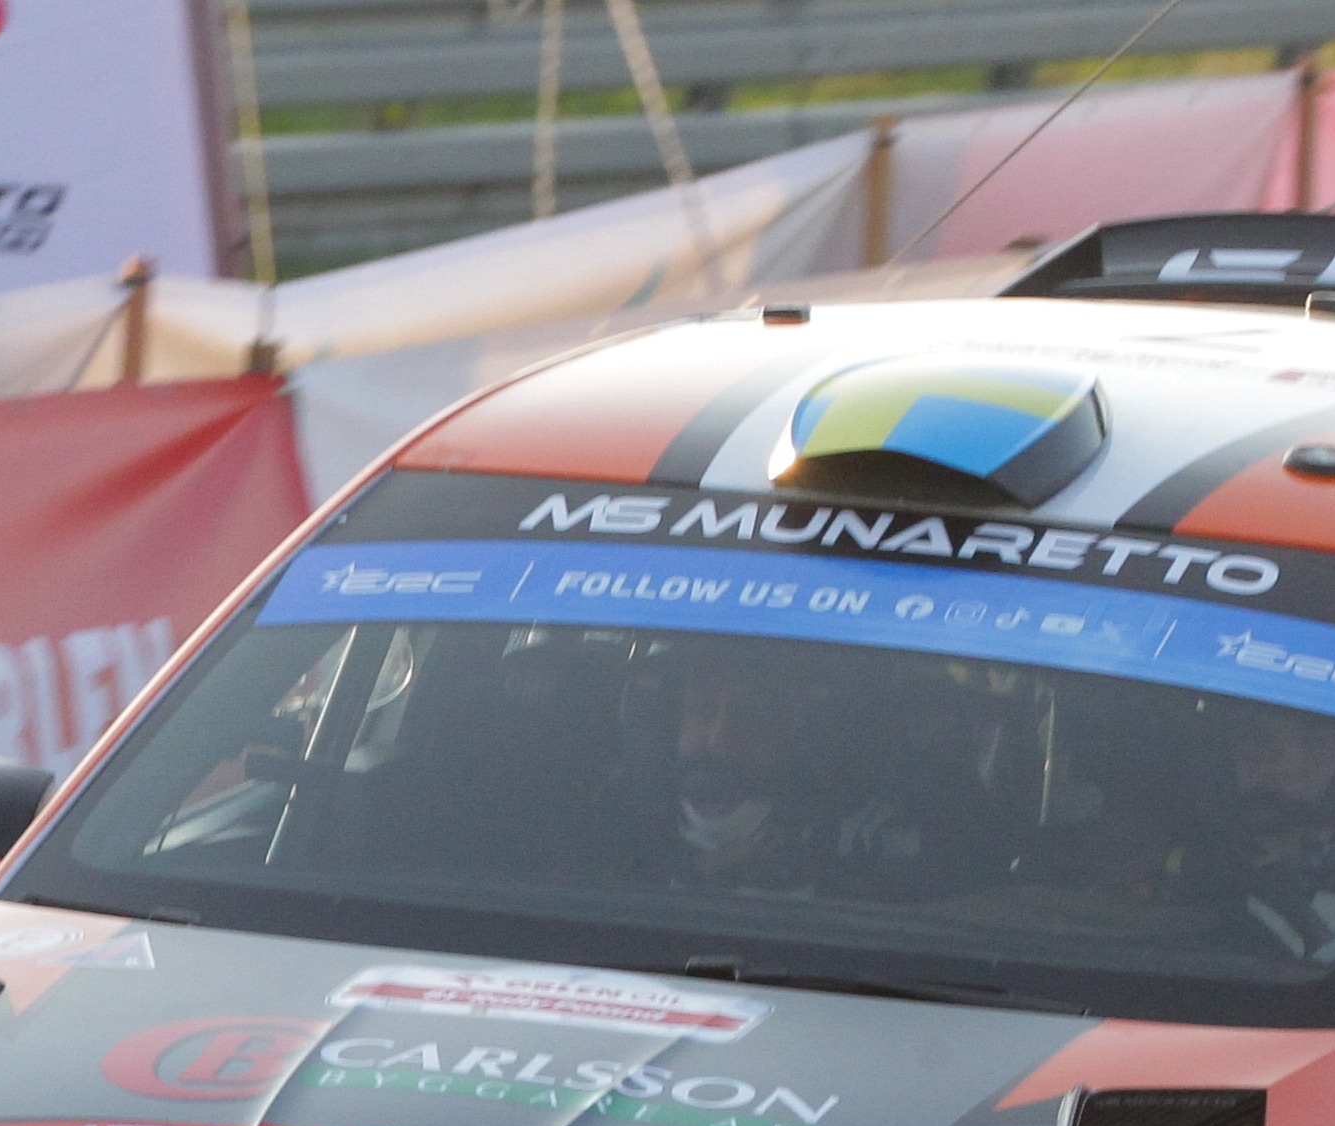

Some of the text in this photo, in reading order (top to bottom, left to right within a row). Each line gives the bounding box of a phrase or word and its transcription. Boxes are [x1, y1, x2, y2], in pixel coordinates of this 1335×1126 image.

[669, 500, 1280, 596] MUNARETTO
[555, 571, 732, 602] FOLLOW
[739, 582, 798, 609] US
[808, 586, 871, 616] ON
[320, 1036, 839, 1125] CARLSSON
